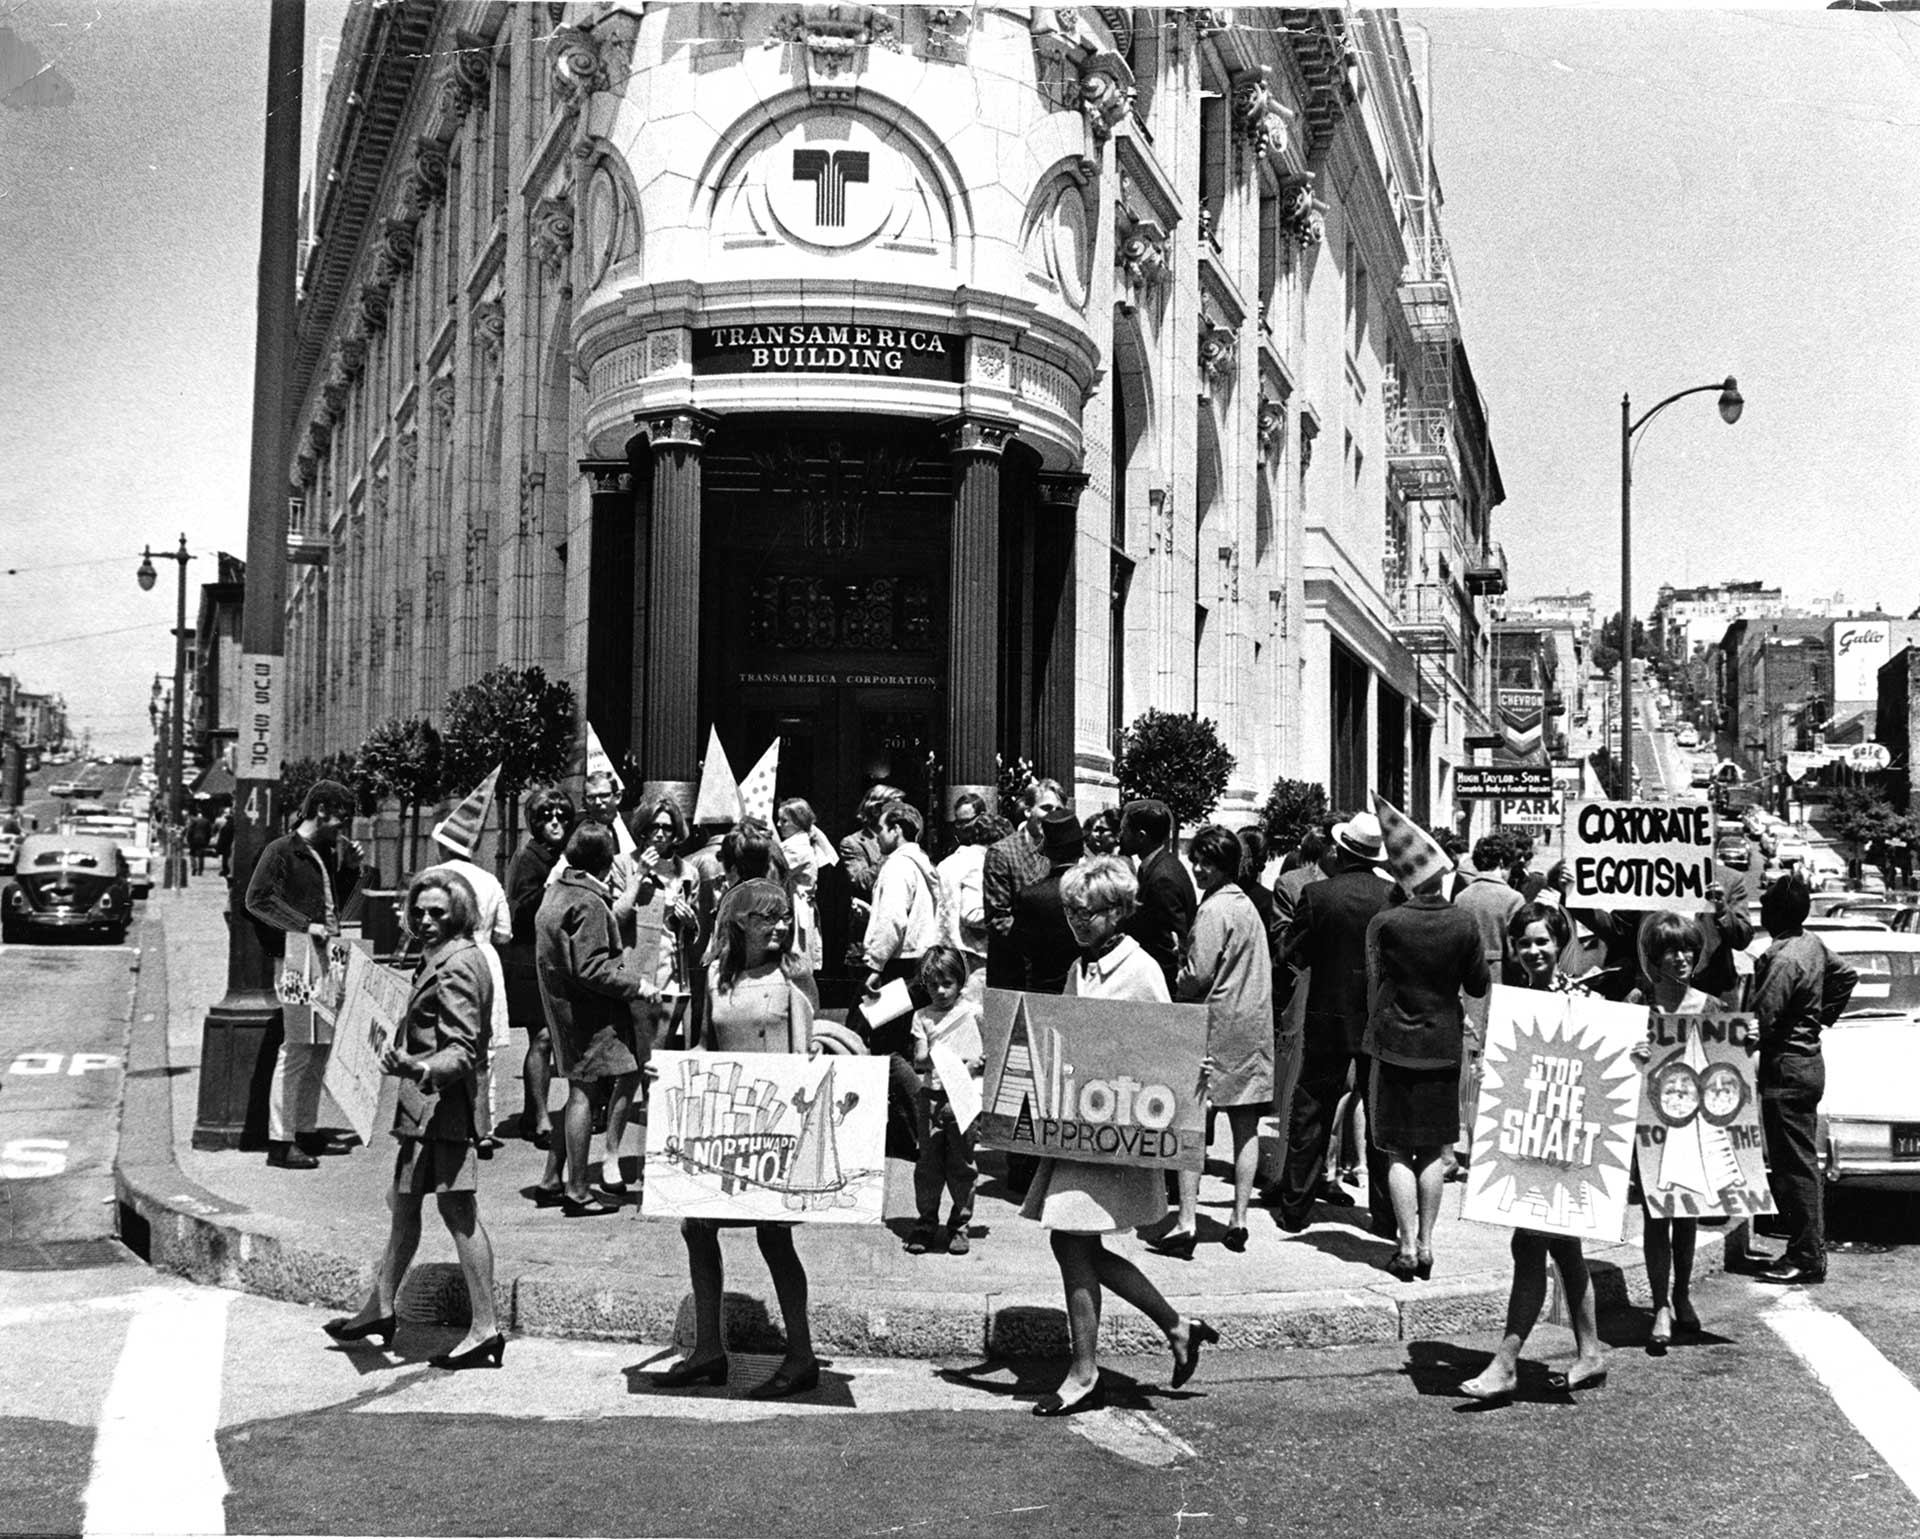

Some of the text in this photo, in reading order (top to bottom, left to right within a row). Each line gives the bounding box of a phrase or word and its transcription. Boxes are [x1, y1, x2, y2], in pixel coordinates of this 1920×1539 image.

[711, 326, 946, 353] TRANSAMERICA
[751, 348, 903, 370] BUILDING
[1838, 629, 1885, 656] Gallo
[739, 673, 936, 685] TRANSAMERICA CORPORATION
[251, 663, 271, 765] BUS STOP
[1501, 694, 1543, 706] CHEVRON
[1457, 772, 1479, 783] HUGH
[1481, 772, 1514, 784] TAYLOR
[244, 787, 271, 827] 41
[1504, 800, 1560, 814] PARK
[1578, 804, 1711, 845] CORPORATE
[1575, 857, 1713, 898] EGOTISM!
[1530, 1054, 1583, 1087] STOP
[1524, 1079, 1586, 1121] THE
[1013, 1091, 1178, 1158] APPROVED
[1499, 1108, 1601, 1165] SHAFT
[1636, 1125, 1761, 1150] TO THE
[1647, 1189, 1772, 1217] VIEW
